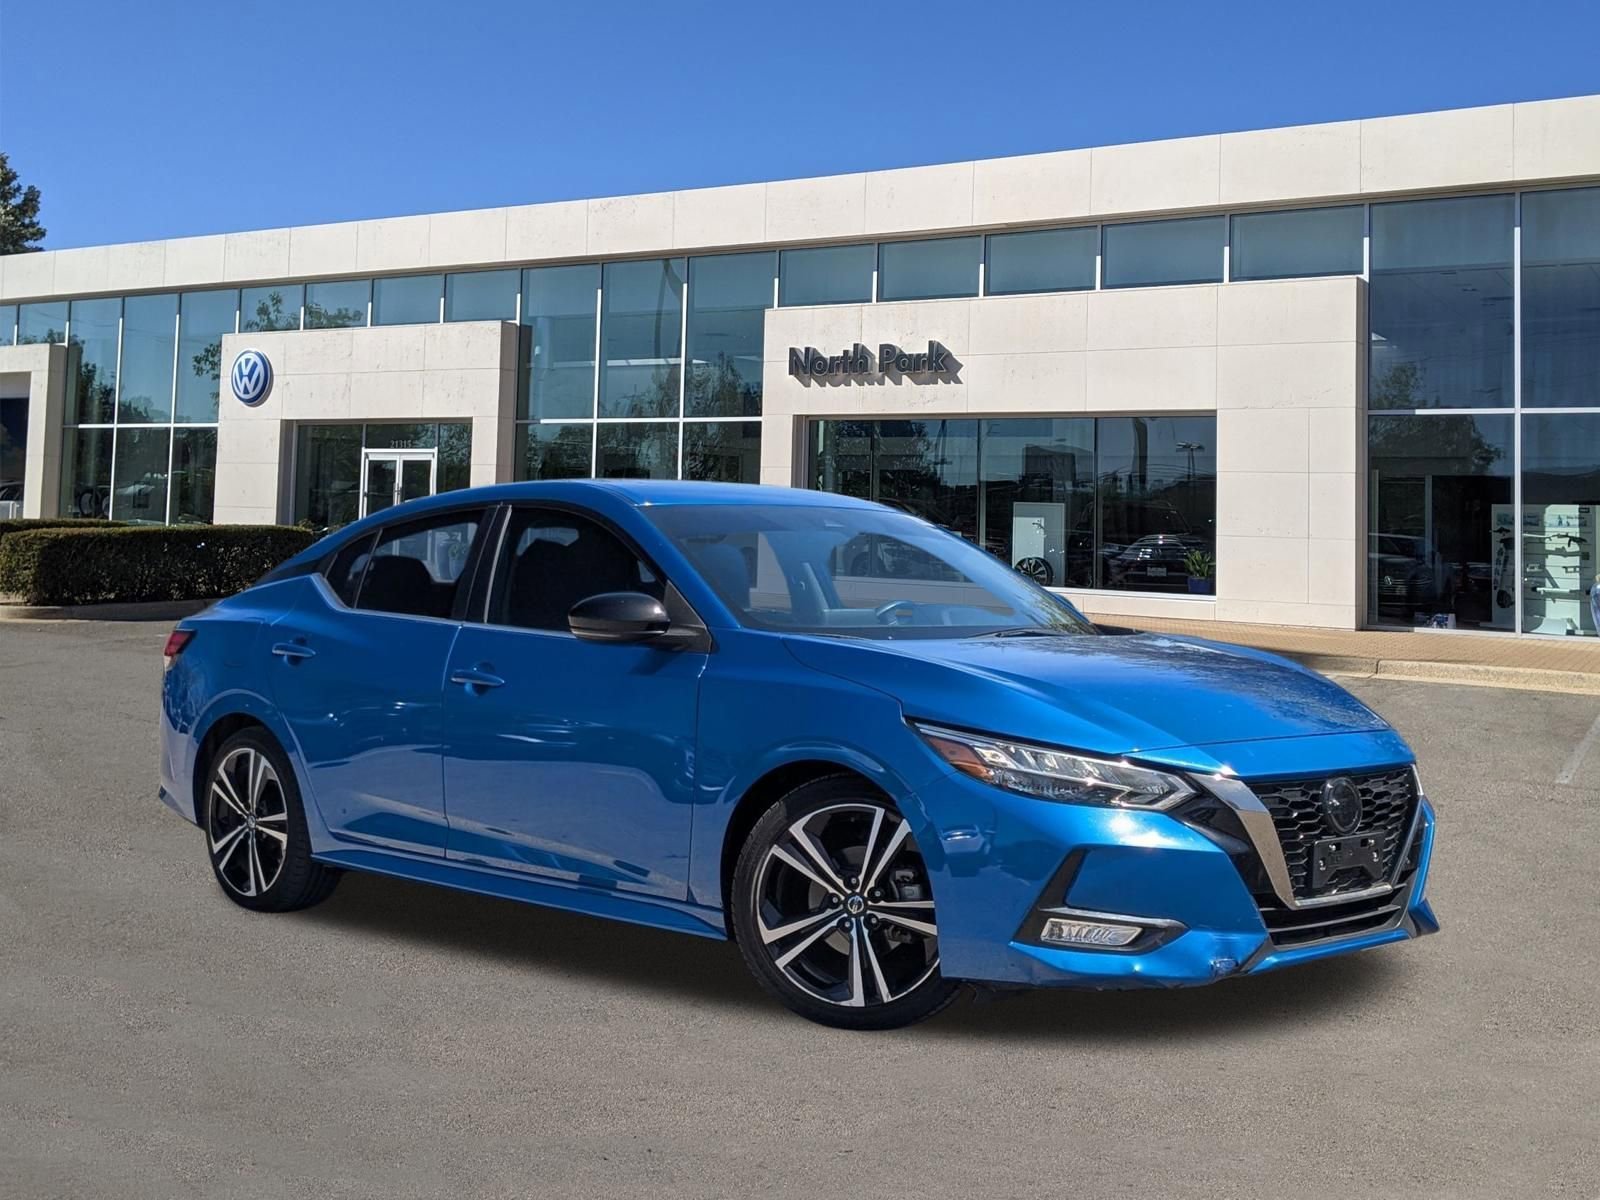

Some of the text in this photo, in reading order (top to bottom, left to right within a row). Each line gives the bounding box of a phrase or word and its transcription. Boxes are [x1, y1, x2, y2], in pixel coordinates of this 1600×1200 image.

[233, 353, 264, 399] VW
[789, 341, 947, 375] North Park
